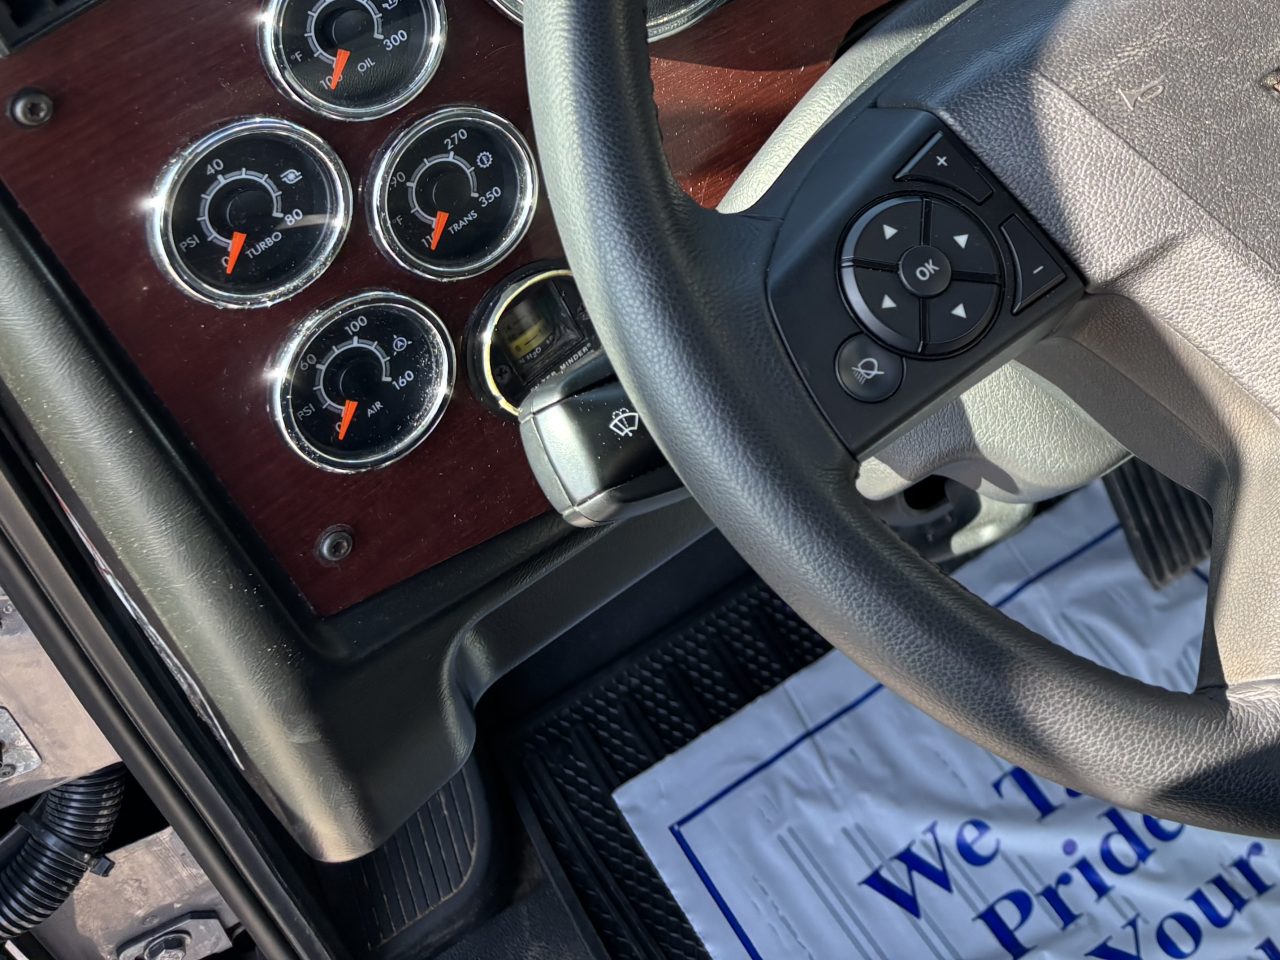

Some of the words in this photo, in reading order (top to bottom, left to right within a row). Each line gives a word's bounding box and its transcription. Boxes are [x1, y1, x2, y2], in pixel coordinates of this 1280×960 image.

[383, 29, 408, 51] 300
[357, 58, 376, 73] OIL
[443, 128, 468, 150] 270
[206, 159, 224, 176] 40
[479, 186, 502, 208] 350
[284, 208, 303, 226] 80
[448, 210, 478, 235] TRANS
[179, 234, 200, 252] PSI
[245, 231, 282, 259] TURBO
[915, 259, 940, 281] OK
[344, 315, 368, 336] 100
[300, 354, 317, 371] 60
[392, 370, 414, 390] 160
[297, 403, 316, 421] PSI
[367, 401, 384, 418] AIR
[858, 818, 1000, 920] We
